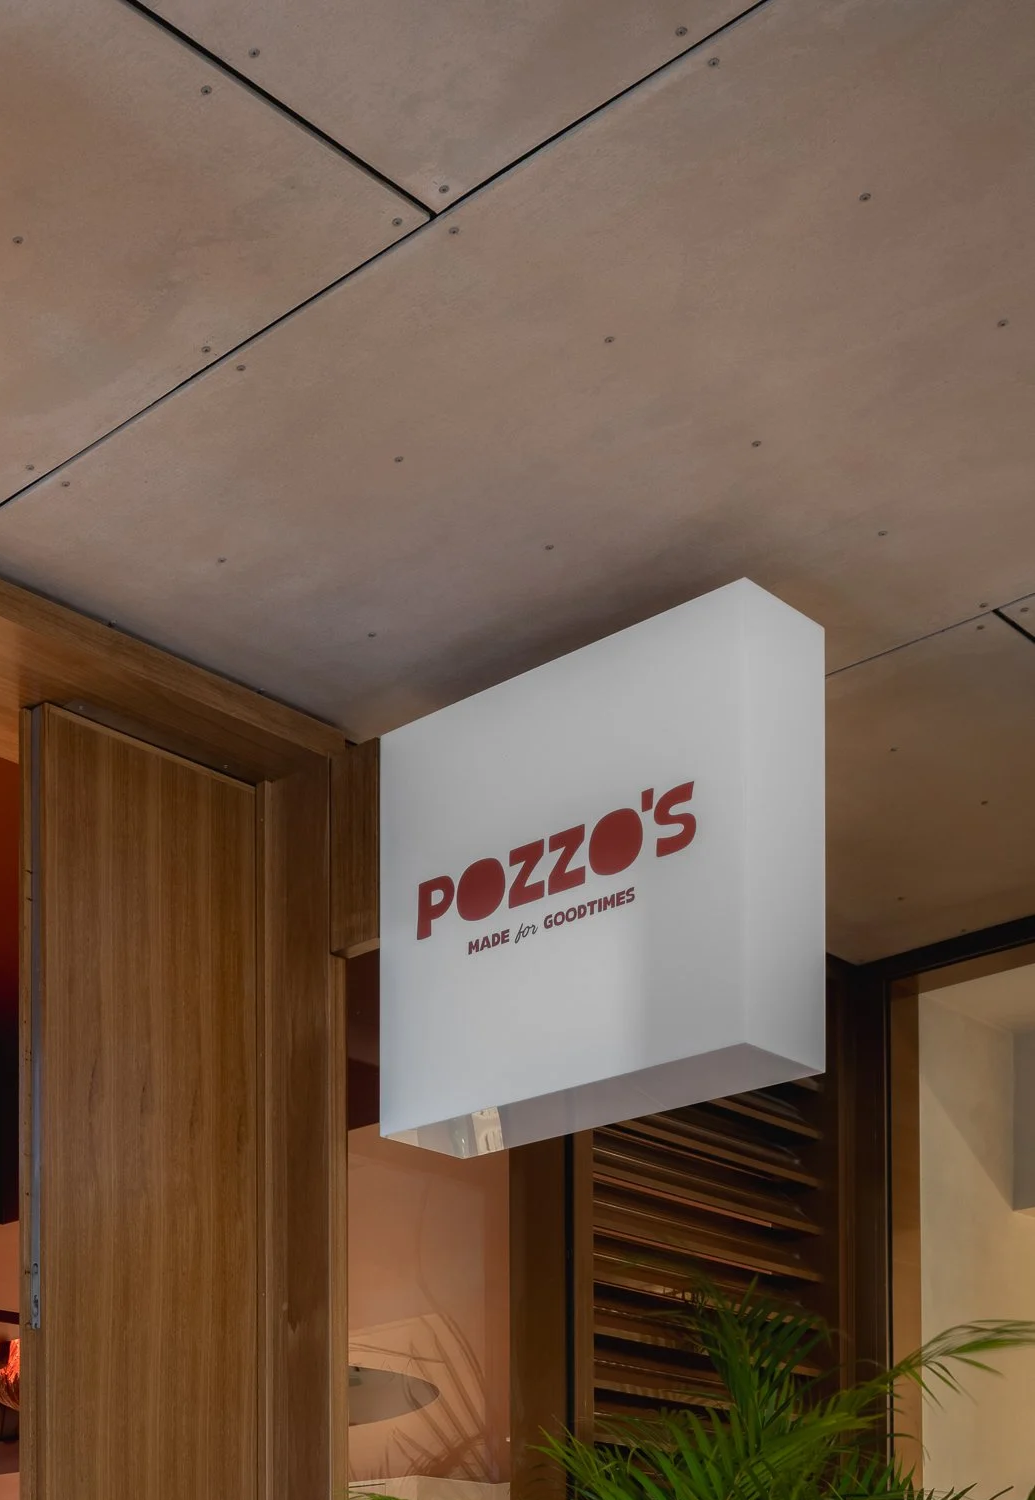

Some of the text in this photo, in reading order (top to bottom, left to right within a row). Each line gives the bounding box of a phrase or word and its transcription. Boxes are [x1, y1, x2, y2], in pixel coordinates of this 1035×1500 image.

[416, 780, 697, 940] POZZO'S
[468, 886, 635, 955] MADE for GOODTIMES
